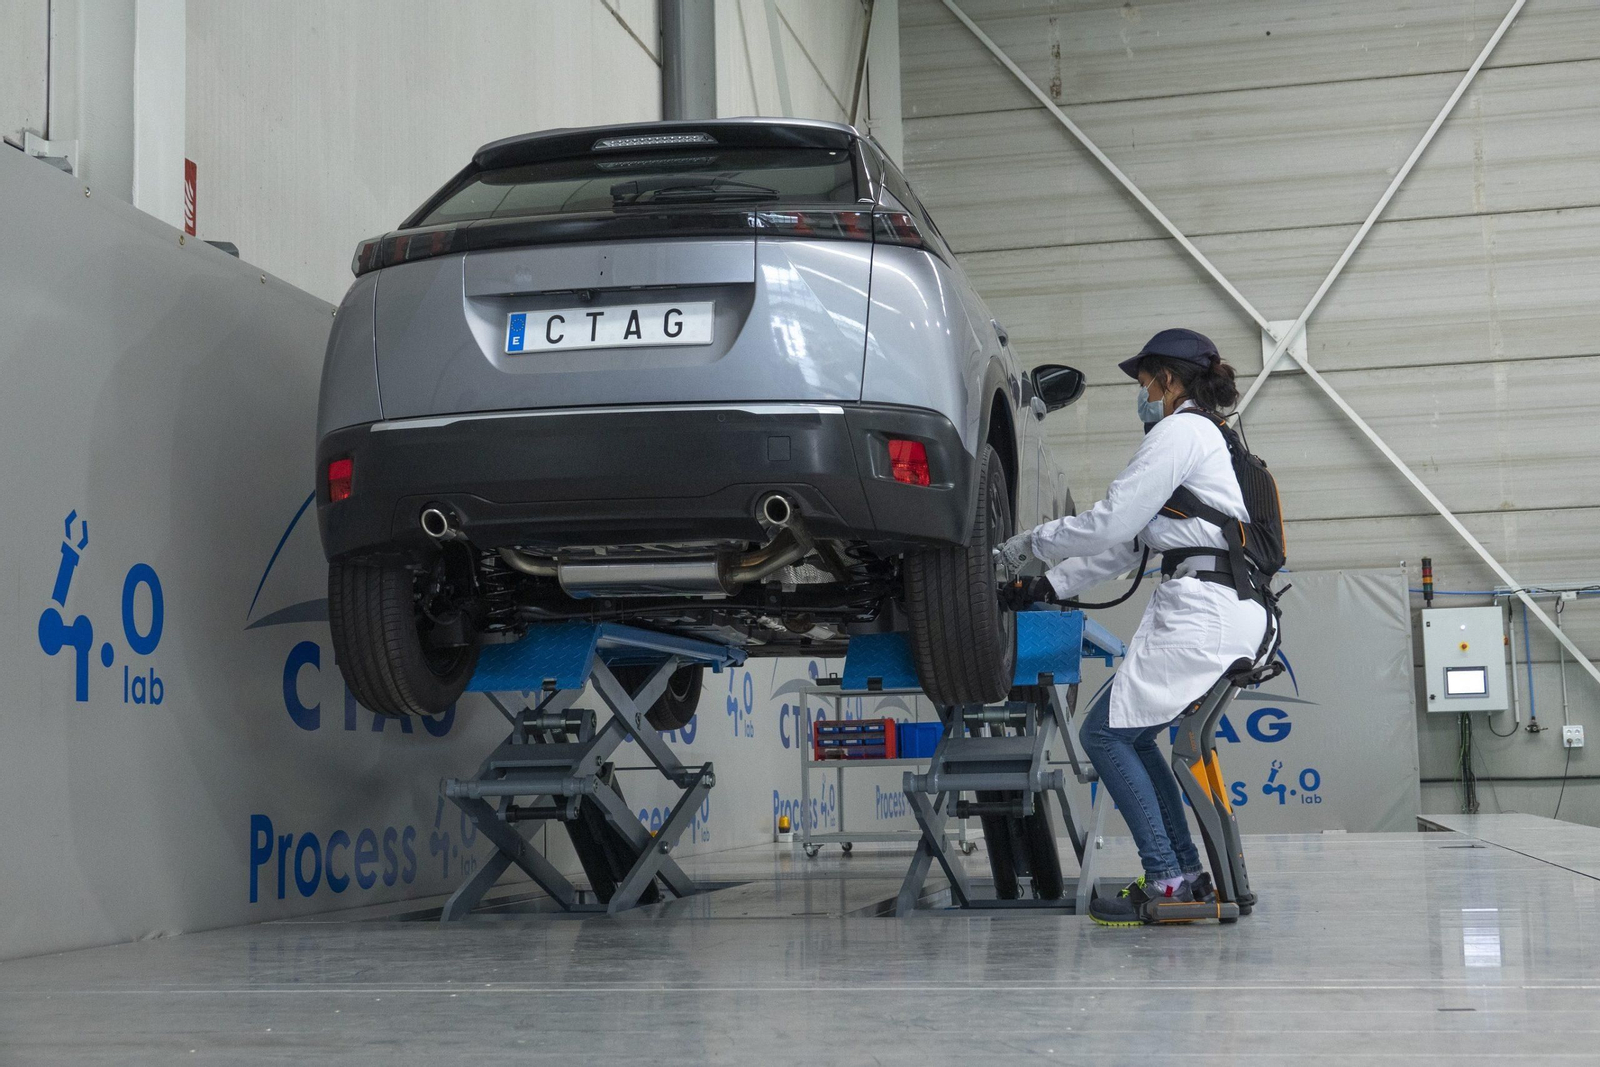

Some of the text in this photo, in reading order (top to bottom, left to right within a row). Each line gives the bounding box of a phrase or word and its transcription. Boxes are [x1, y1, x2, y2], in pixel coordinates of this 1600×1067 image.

[512, 308, 684, 346] E CTAG
[124, 665, 165, 706] lab
[875, 784, 906, 821] Process
[1301, 793, 1323, 805] lab
[249, 813, 418, 904] Process
